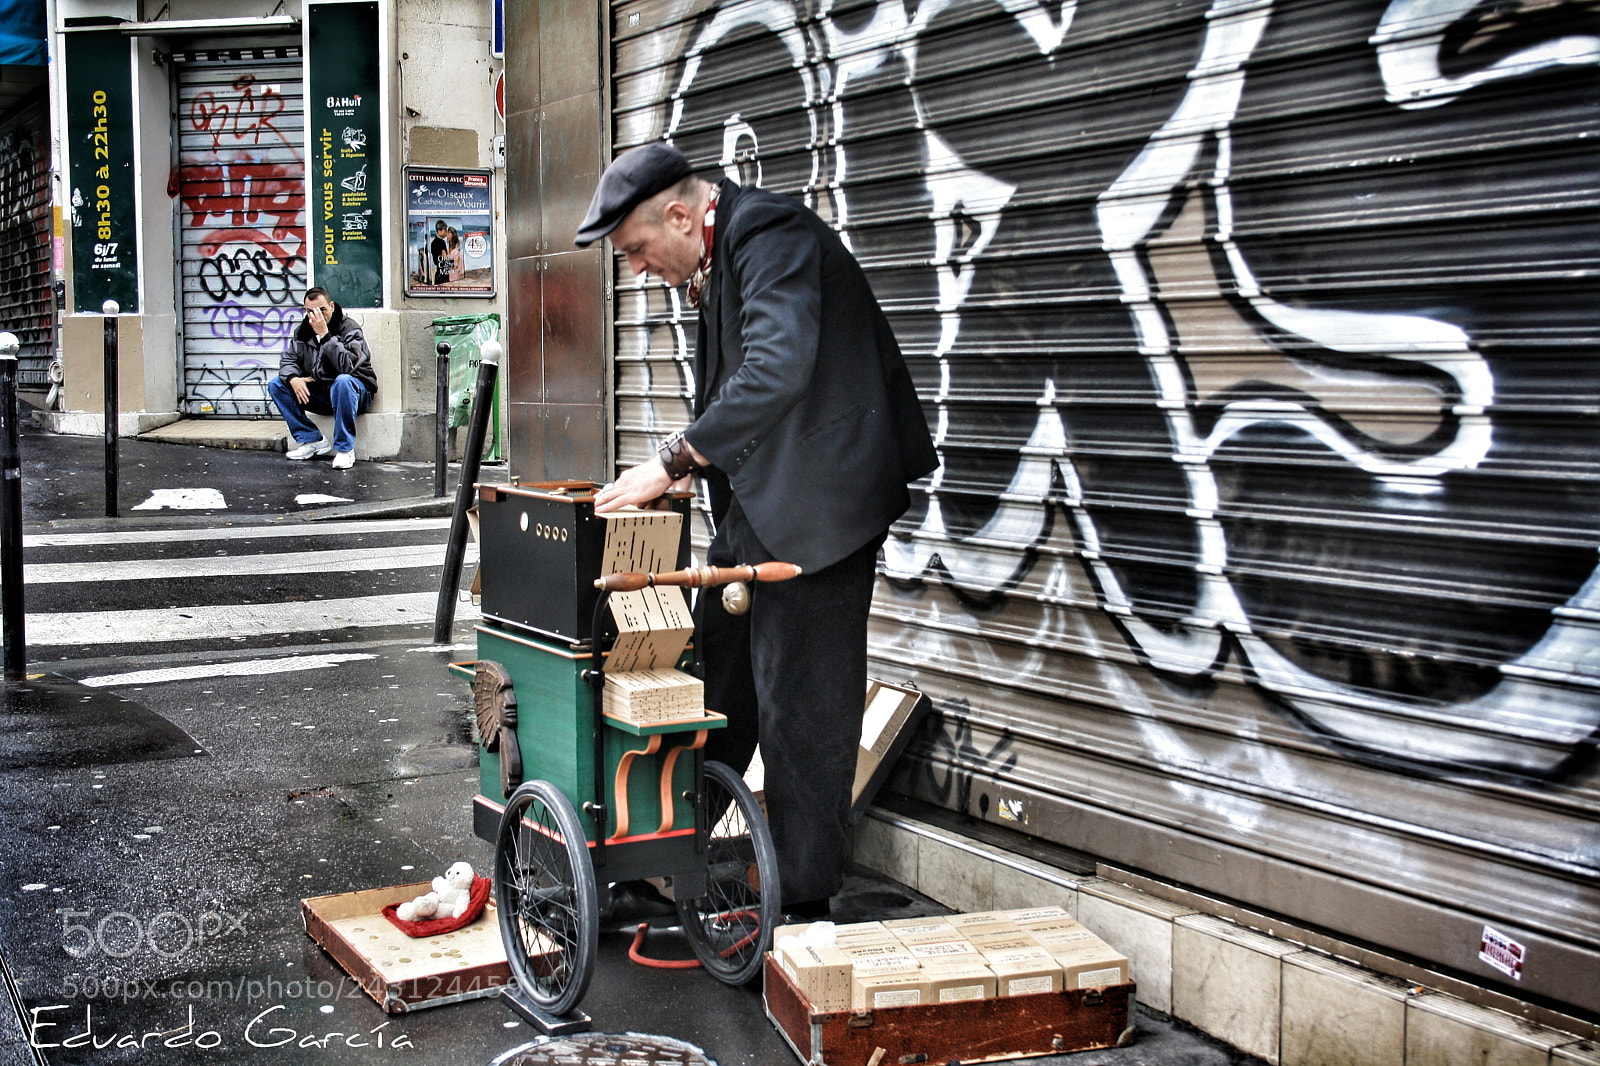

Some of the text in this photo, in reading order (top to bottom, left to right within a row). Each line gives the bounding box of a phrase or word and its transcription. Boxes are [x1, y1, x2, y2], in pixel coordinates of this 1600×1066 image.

[93, 90, 111, 240] 8h30 à 22h30
[320, 128, 338, 265] pour vous servir
[409, 174, 424, 182] CETTE
[425, 175, 449, 183] SEMAINE
[94, 243, 118, 256] 6j/7
